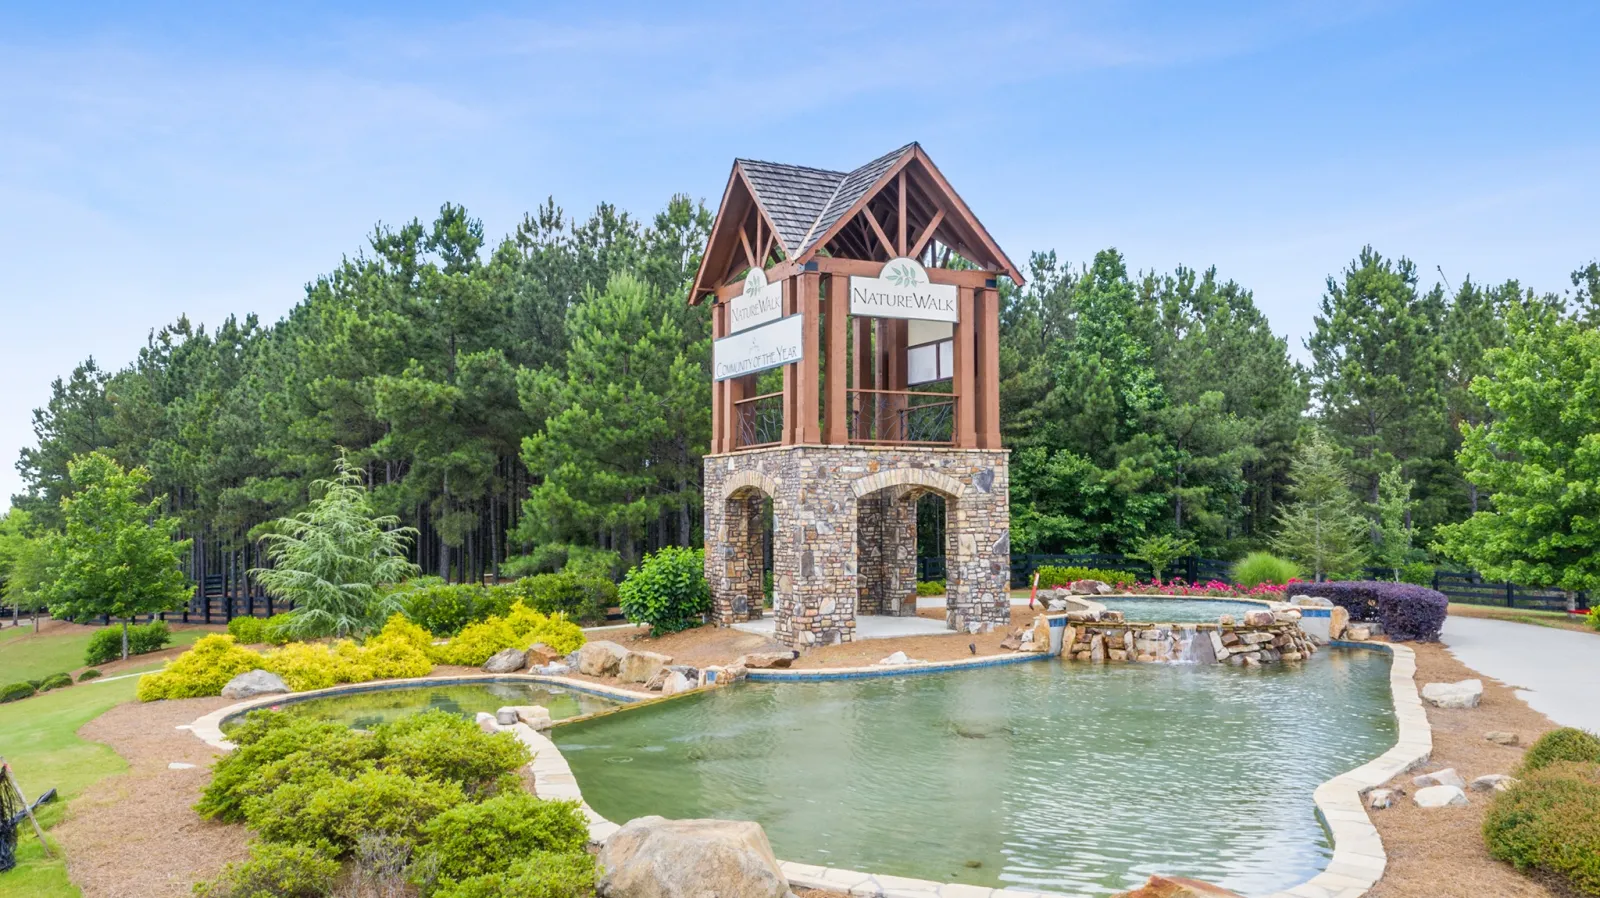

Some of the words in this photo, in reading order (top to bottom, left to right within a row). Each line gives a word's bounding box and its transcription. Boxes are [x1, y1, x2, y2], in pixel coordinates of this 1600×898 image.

[716, 358, 753, 377] COMMUNITY
[753, 356, 761, 367] OF
[762, 352, 776, 365] THE
[776, 345, 797, 361] YEAR
